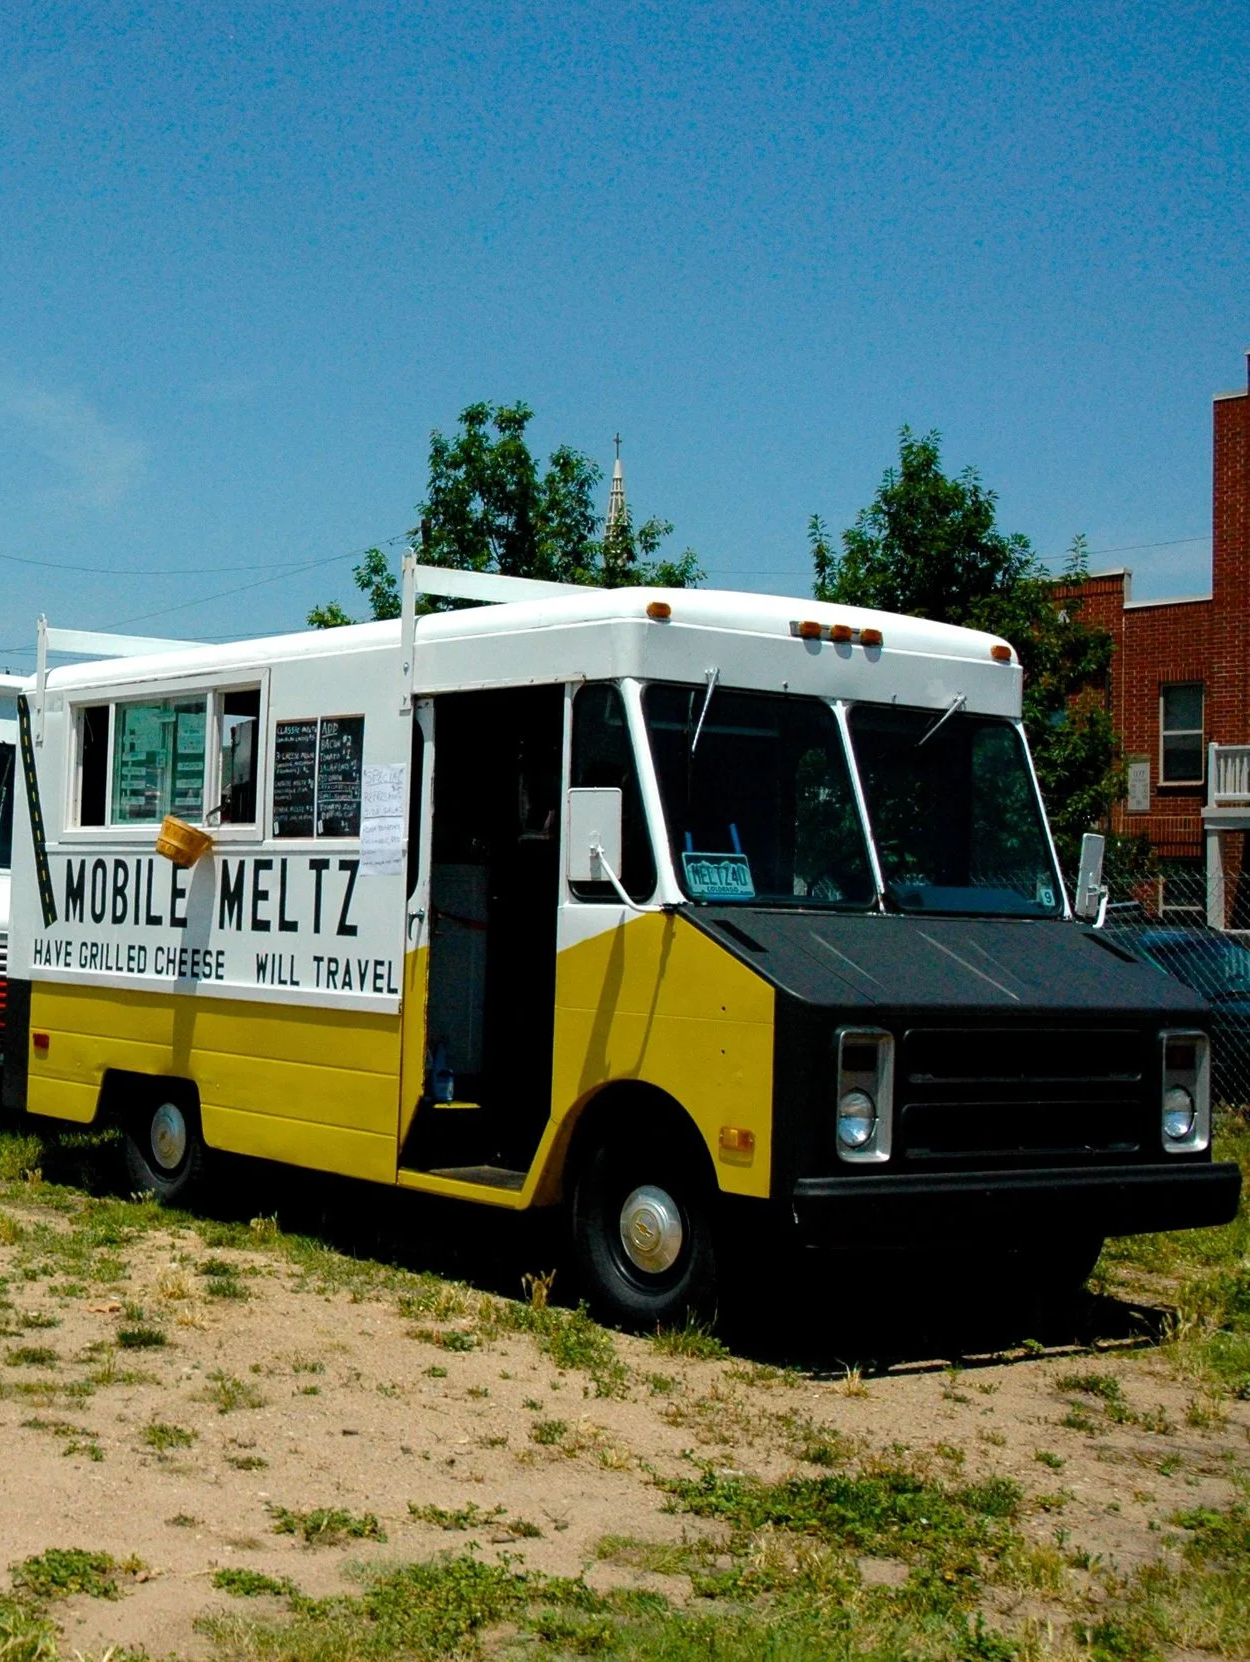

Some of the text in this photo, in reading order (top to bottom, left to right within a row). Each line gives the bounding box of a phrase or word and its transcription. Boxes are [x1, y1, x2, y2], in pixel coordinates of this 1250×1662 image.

[322, 721, 339, 734] ADD
[320, 738, 341, 751] BACON
[65, 858, 360, 936] MOBILE MELTZ
[1044, 891, 1052, 904] 9
[34, 939, 399, 995] HAVE GRILLED CHEESE WILL TRAVEL
